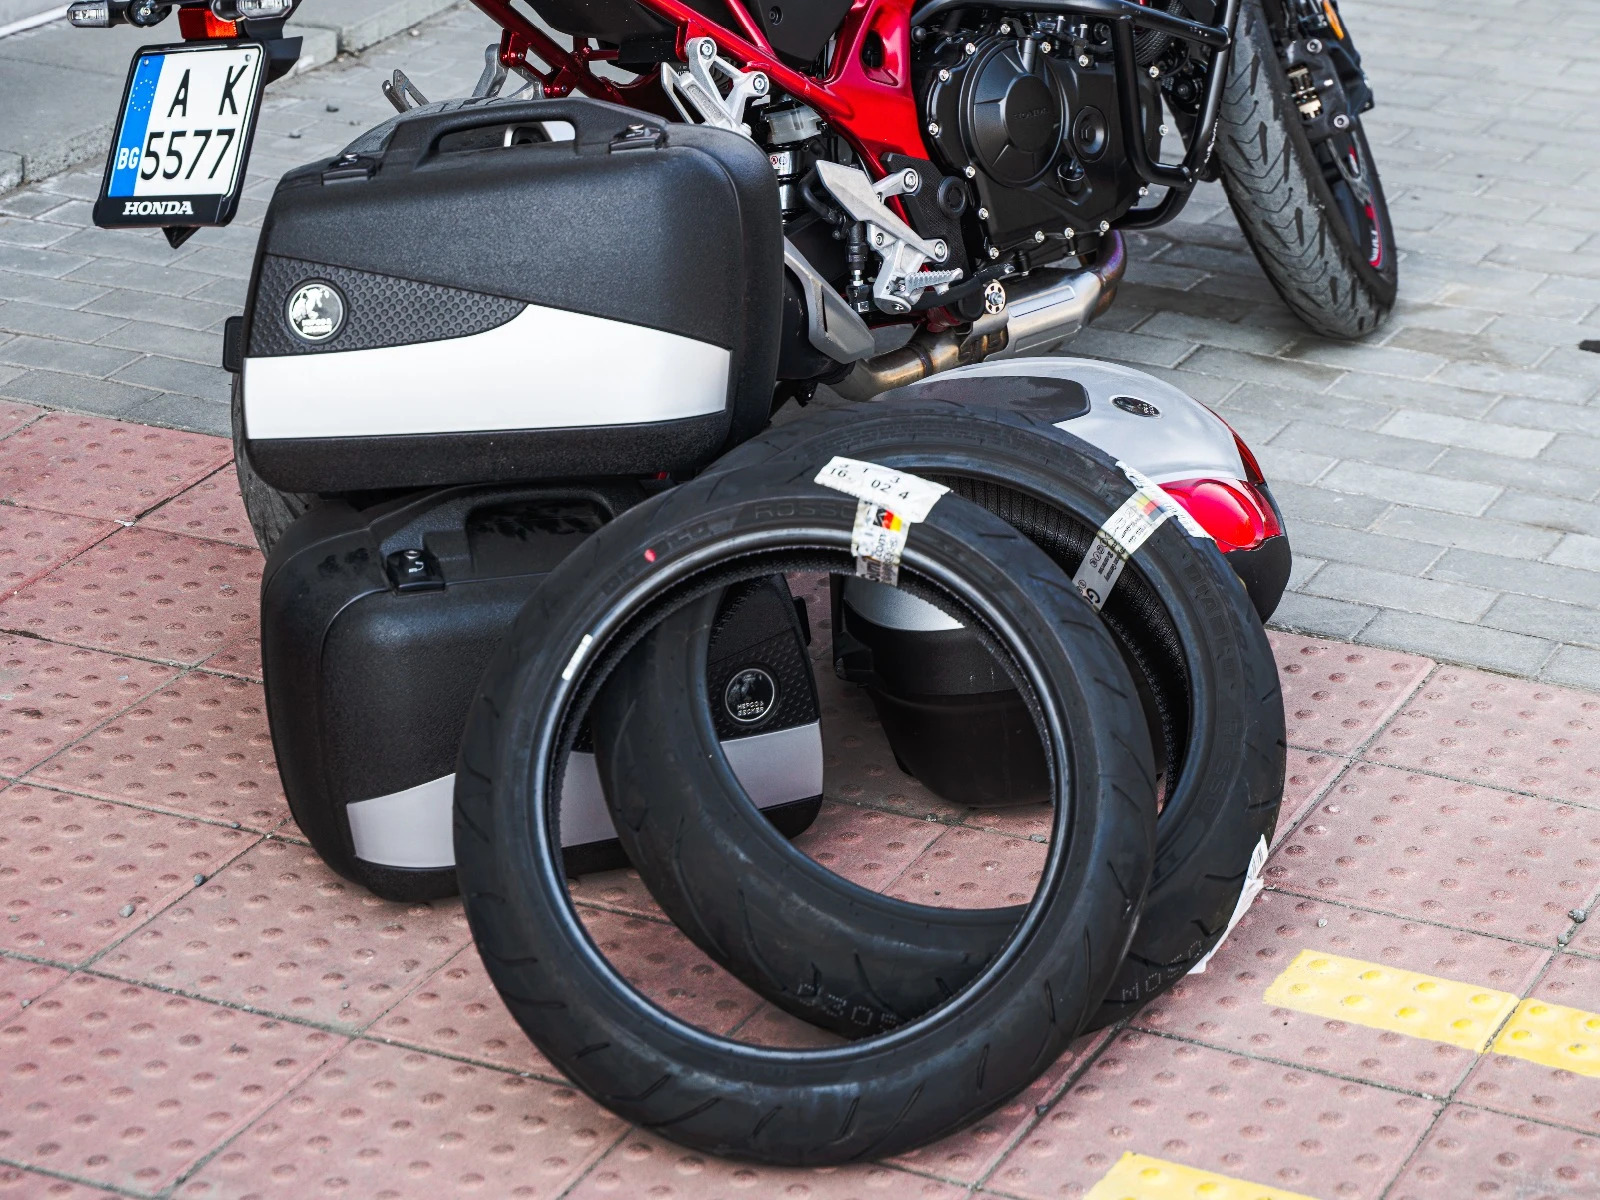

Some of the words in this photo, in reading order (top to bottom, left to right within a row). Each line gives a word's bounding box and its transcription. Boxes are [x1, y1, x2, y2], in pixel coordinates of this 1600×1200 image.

[167, 69, 190, 118] A
[218, 65, 249, 116] K
[117, 147, 140, 170] BG
[140, 128, 236, 181] 5577
[122, 201, 194, 215] HONDA
